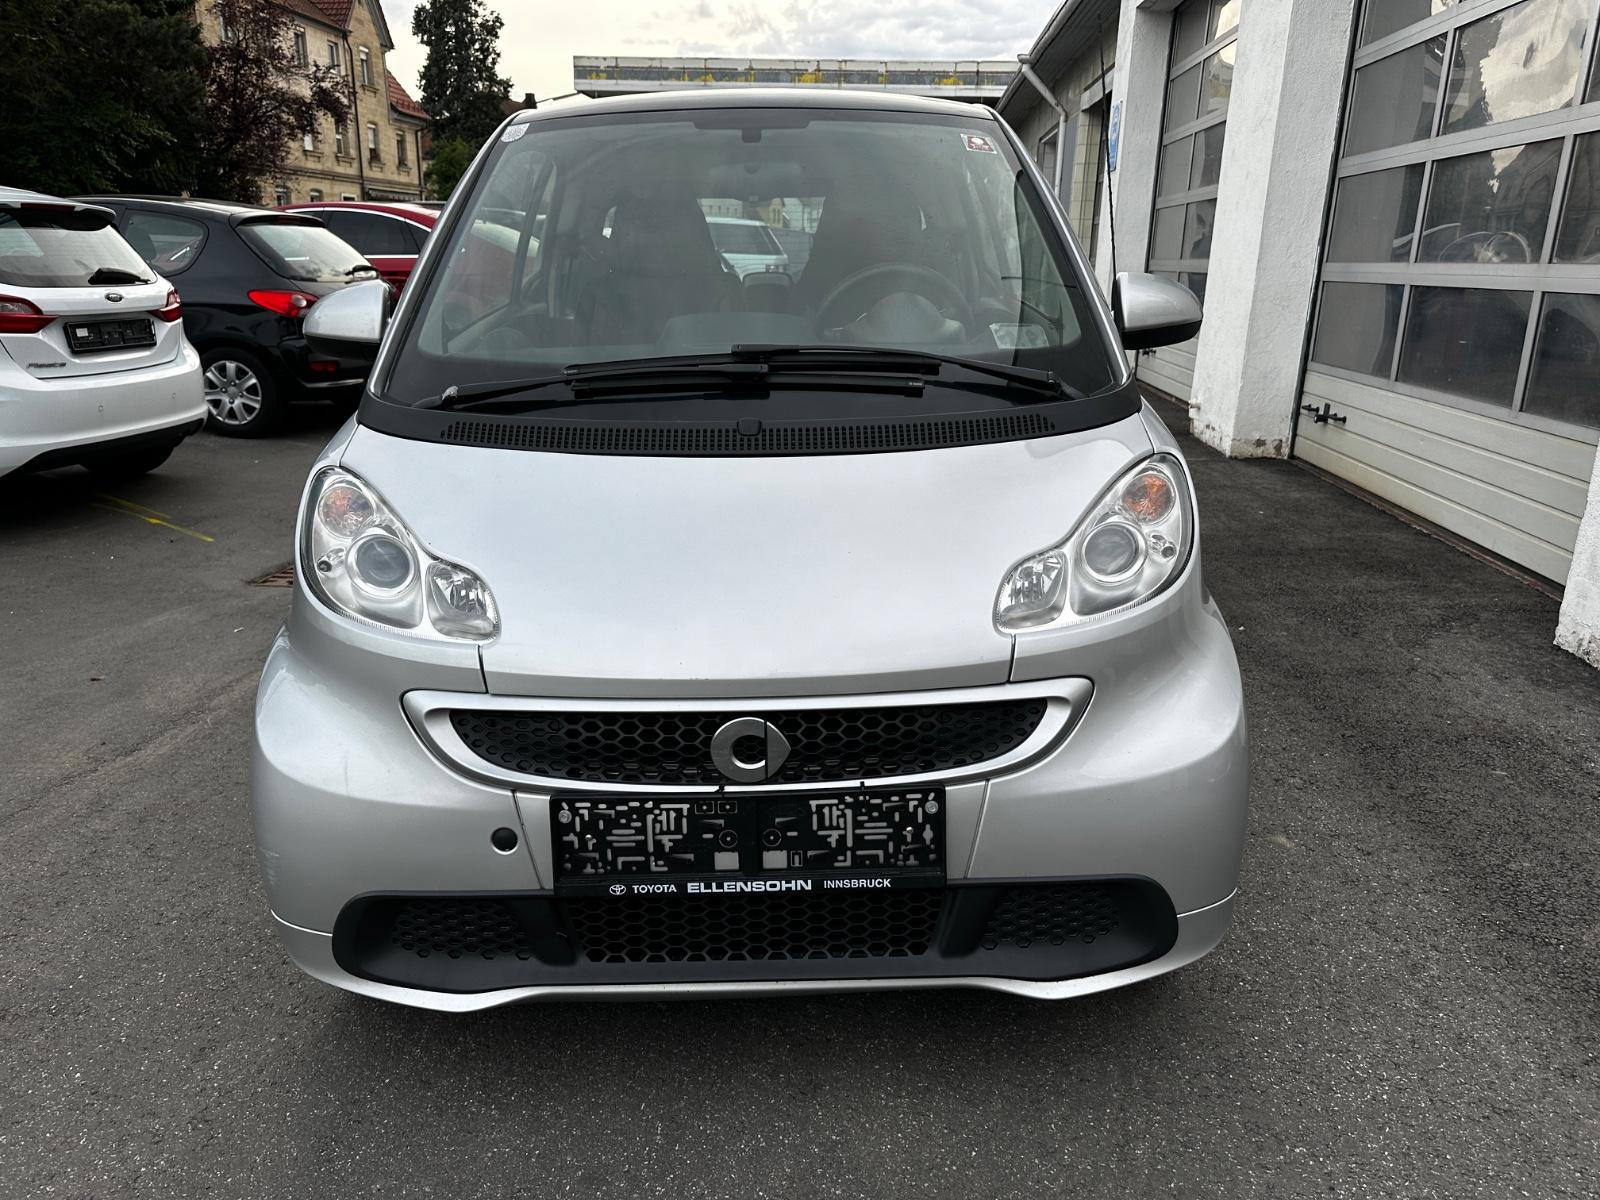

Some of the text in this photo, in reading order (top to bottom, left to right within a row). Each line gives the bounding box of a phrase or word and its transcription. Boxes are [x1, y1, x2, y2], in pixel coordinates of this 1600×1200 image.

[632, 878, 891, 894] TOYOTA ELLENSOHN INNSBRUCK
